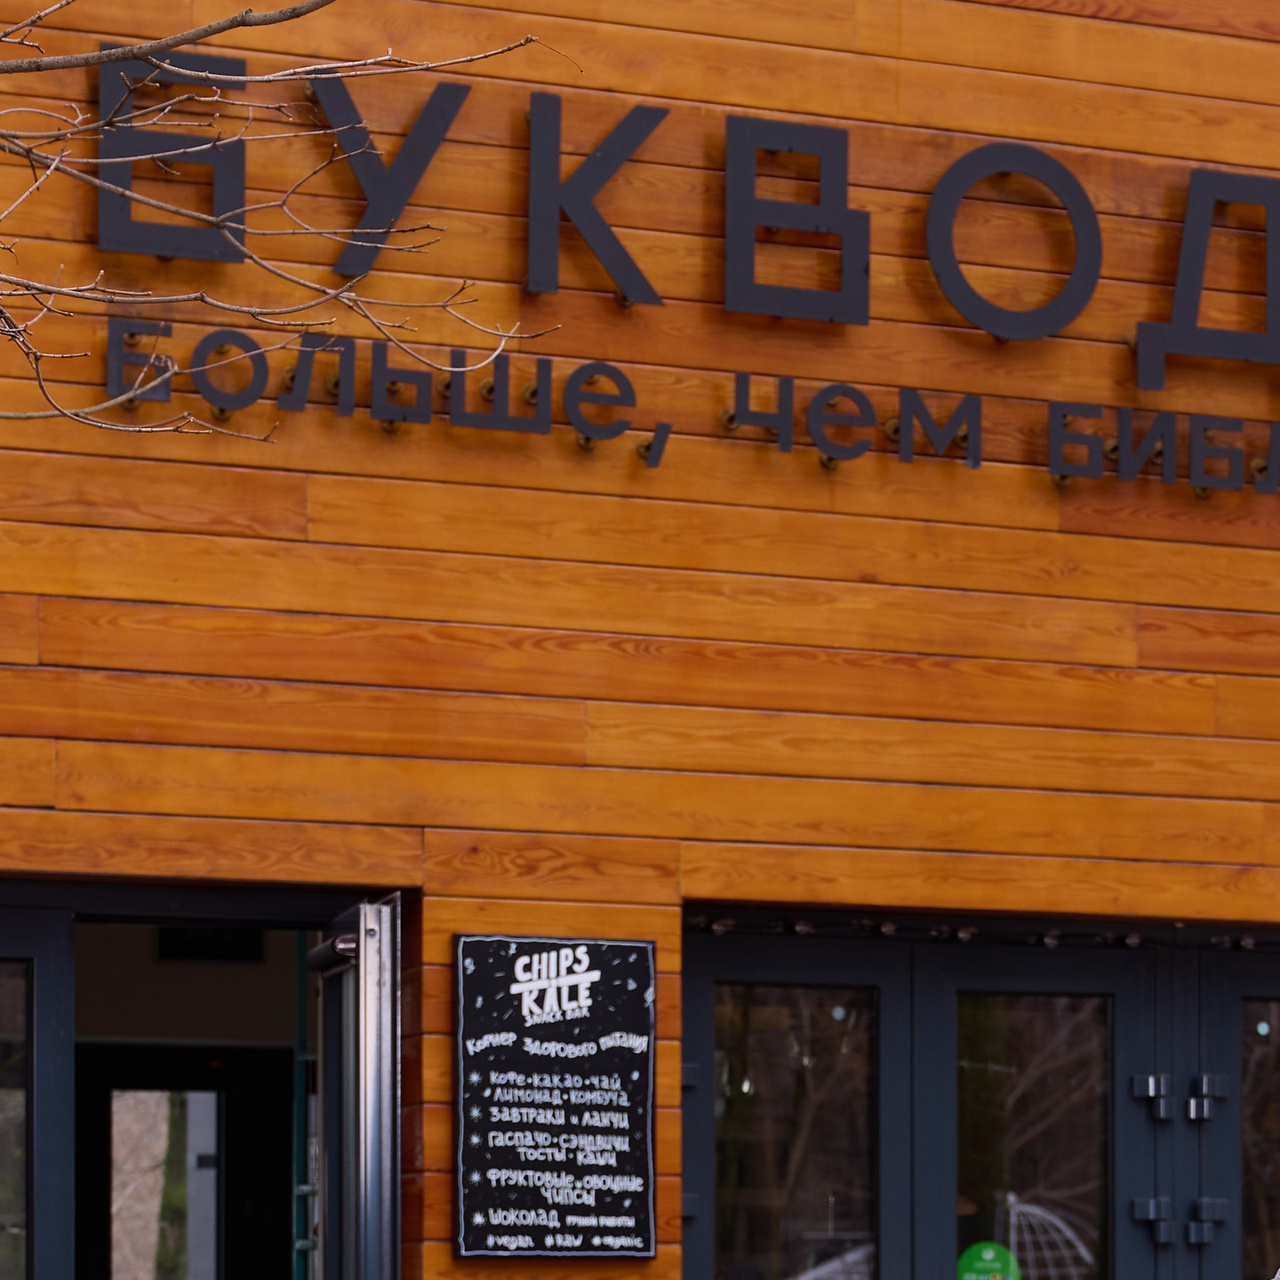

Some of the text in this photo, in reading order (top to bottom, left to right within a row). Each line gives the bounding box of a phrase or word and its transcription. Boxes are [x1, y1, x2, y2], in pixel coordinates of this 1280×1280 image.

[106, 316, 673, 468] Больше,
[734, 371, 983, 469] чем
[514, 944, 590, 982] CHIPS
[521, 981, 593, 1017] KALE
[524, 1006, 590, 1027] SNACK BAR
